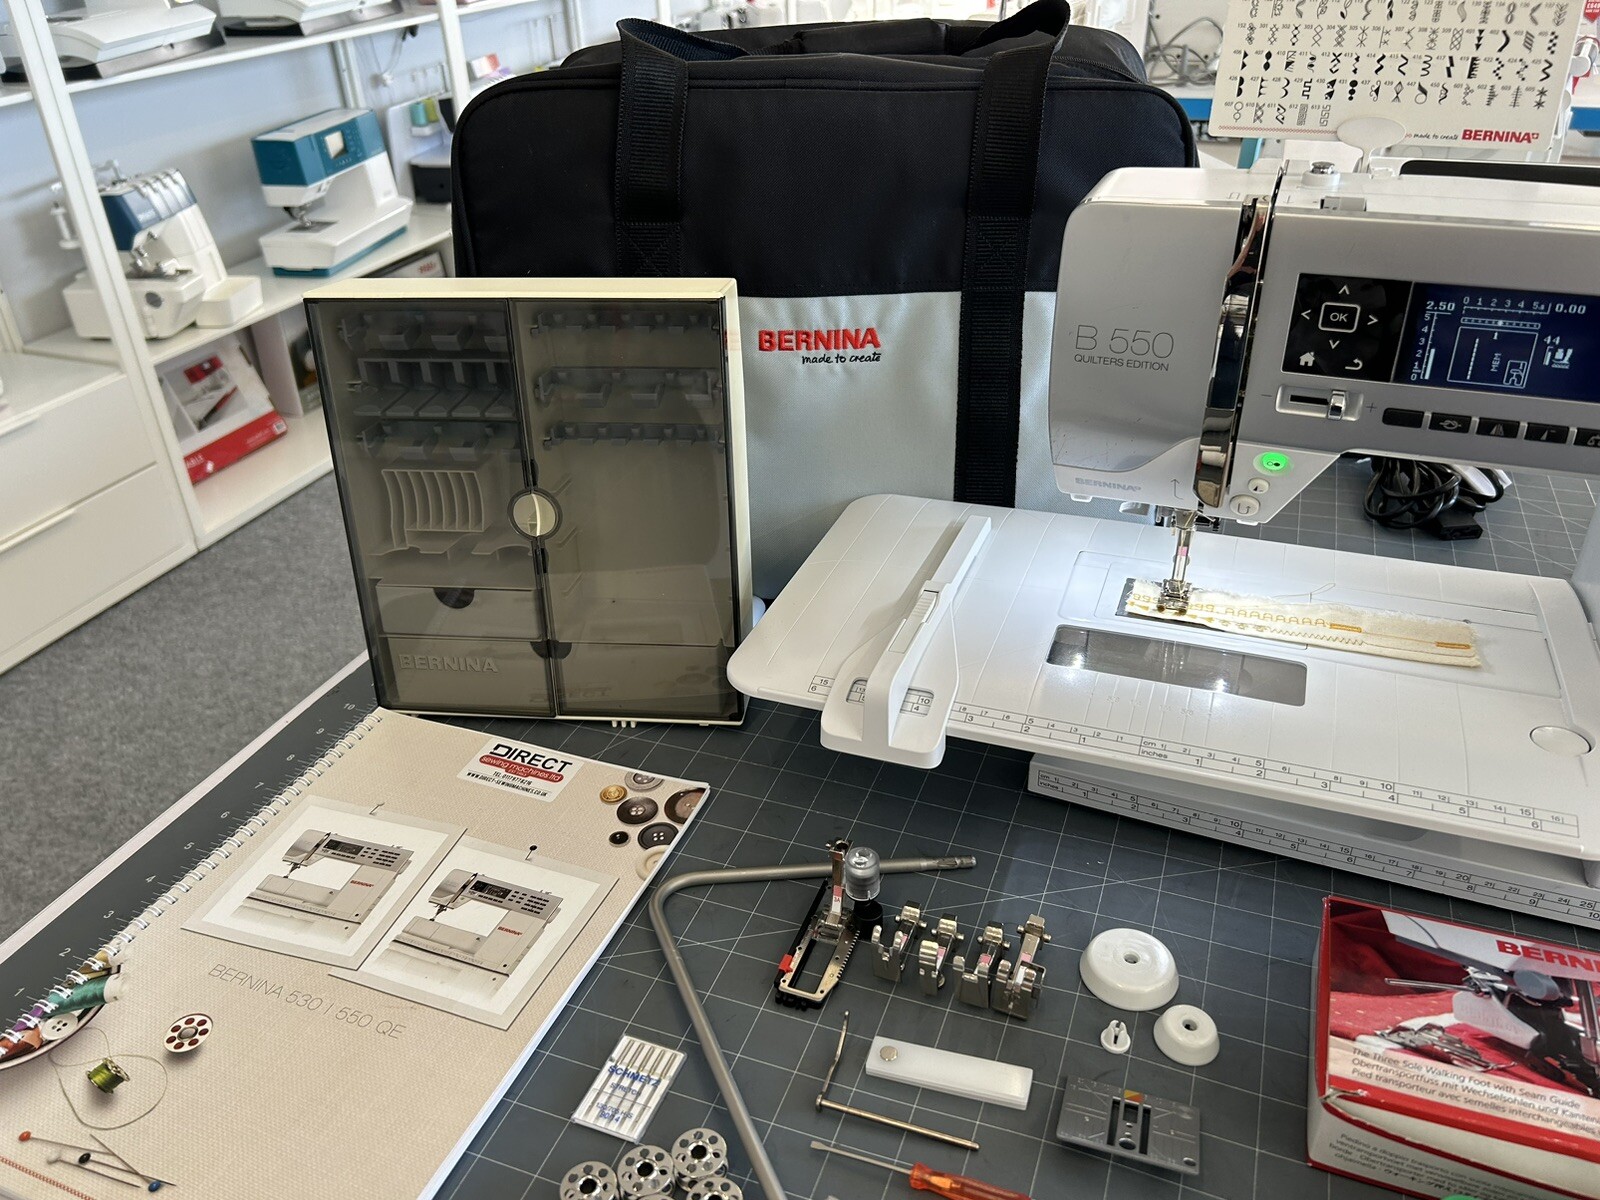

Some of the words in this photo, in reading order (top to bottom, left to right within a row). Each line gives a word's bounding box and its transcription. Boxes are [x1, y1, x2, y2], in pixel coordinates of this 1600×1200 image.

[1462, 129, 1532, 143] BERNINA
[1426, 301, 1455, 311] 2.50
[1555, 303, 1586, 314] 0.00
[1330, 312, 1348, 323] OK
[758, 328, 881, 351] BERNINA
[1075, 324, 1098, 351] B
[1109, 328, 1174, 358] 550
[1544, 335, 1560, 345] 44
[802, 353, 833, 364] made
[835, 354, 846, 363] to
[849, 352, 881, 363] create
[1074, 354, 1124, 367] QUILTERS
[1127, 359, 1169, 371] EDITION
[1490, 353, 1502, 372] MEM
[1075, 477, 1136, 492] BERNINA
[400, 654, 498, 673] BERNINA
[286, 754, 295, 762] 8
[490, 744, 572, 772] DIRECT
[1140, 749, 1168, 759] inches
[482, 757, 509, 768] sewing
[510, 763, 548, 778] machines
[549, 773, 561, 781] ltd
[1039, 780, 1058, 789] inches
[221, 810, 230, 819] 6
[1519, 808, 1531, 816] 15
[184, 841, 195, 851] 5
[146, 874, 156, 884] 4
[1456, 873, 1469, 881] 20
[1580, 900, 1593, 908] 25
[104, 910, 115, 920] 3
[58, 947, 72, 957] 2
[14, 987, 25, 997] 1
[208, 963, 284, 999] BERNINA
[285, 990, 323, 1010] 530
[335, 1007, 373, 1027] 550
[376, 1020, 406, 1039] QE
[608, 1064, 661, 1086] SCHMETZ
[1353, 1047, 1370, 1057] The
[1373, 1052, 1400, 1066] Three
[1403, 1060, 1423, 1071] Sole
[1426, 1066, 1466, 1083] Walking
[1468, 1076, 1490, 1088] Foot
[1494, 1083, 1516, 1094] with
[1519, 1089, 1546, 1101] Seam
[1550, 1095, 1580, 1109] Guide
[610, 1082, 640, 1096] STRETCH
[1352, 1058, 1439, 1086] Obertransportfuss
[1442, 1081, 1458, 1091] mit
[1461, 1085, 1535, 1109] Wechselsohlen
[1538, 1105, 1558, 1115] und
[1352, 1068, 1372, 1079] Pied
[1376, 1074, 1436, 1096] transporteur
[1438, 1090, 1462, 1099] avec
[1464, 1096, 1506, 1113] semelles
